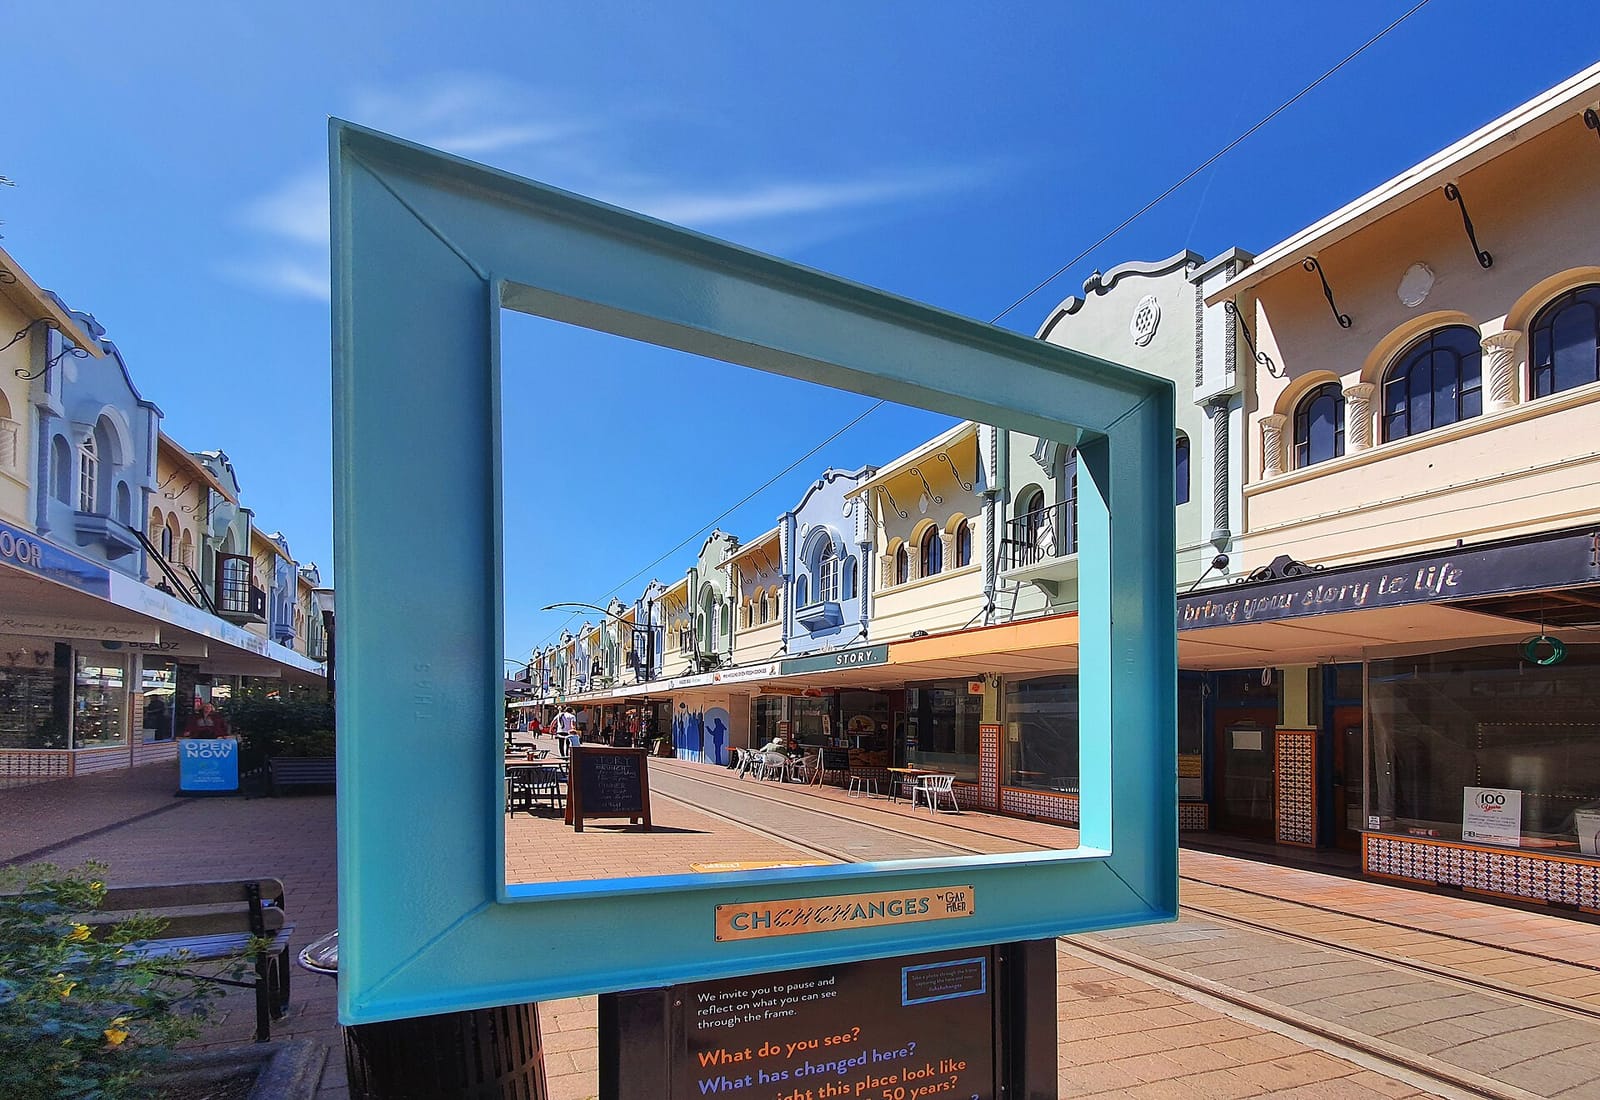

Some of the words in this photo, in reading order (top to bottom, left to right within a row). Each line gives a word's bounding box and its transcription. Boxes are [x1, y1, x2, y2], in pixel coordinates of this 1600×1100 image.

[1184, 600, 1239, 622] bring
[1244, 592, 1299, 619] your
[1302, 582, 1370, 605] story
[1379, 574, 1408, 595] to
[1415, 562, 1462, 596] life
[185, 742, 232, 750] OPEN
[187, 750, 230, 758] NOW
[1480, 794, 1506, 805] 100
[945, 891, 965, 903] GAP
[946, 902, 966, 913] FILLER
[697, 993, 716, 1003] We
[719, 989, 749, 1000] invite
[751, 987, 771, 998] you
[773, 985, 785, 993] to
[786, 981, 815, 993] pause
[817, 976, 835, 987] and
[697, 1003, 733, 1016] reflect
[736, 1003, 750, 1011] on
[752, 999, 777, 1008] what
[780, 996, 799, 1007] you
[801, 993, 819, 1001] can
[821, 990, 837, 999] see
[698, 1014, 741, 1030] through
[744, 1013, 762, 1023] the
[764, 1009, 797, 1019] frame.
[698, 1048, 752, 1068] What
[758, 1041, 781, 1058] do
[786, 1039, 818, 1059] you
[824, 1026, 860, 1046] see?
[698, 1074, 752, 1095] What
[758, 1069, 789, 1084] has
[794, 1051, 867, 1077] changed
[872, 1041, 917, 1062] here?
[818, 1081, 850, 1099] this
[855, 1075, 898, 1097] place
[902, 1063, 935, 1082] look
[940, 1059, 967, 1074] like
[882, 1087, 905, 1100] 50
[910, 1075, 958, 1100] years?
